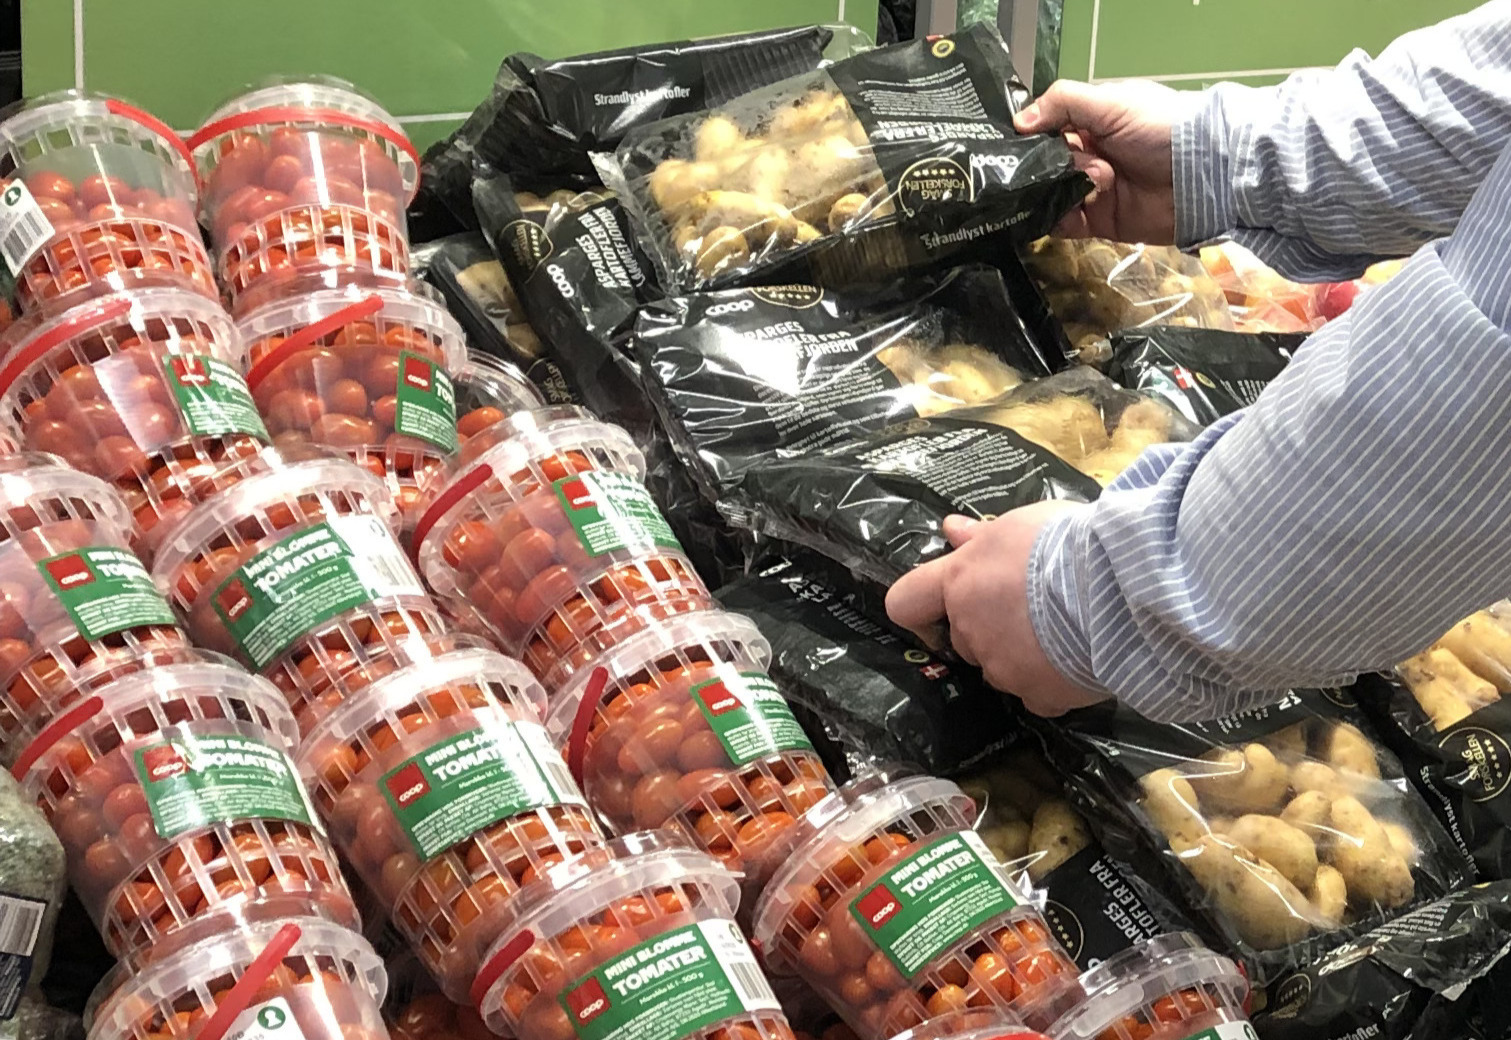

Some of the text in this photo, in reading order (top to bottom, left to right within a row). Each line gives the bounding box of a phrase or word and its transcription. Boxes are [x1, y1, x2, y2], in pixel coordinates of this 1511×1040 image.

[920, 226, 985, 250] Strandlyst
[575, 234, 618, 289] ASPARGES
[547, 264, 575, 298] coop
[705, 299, 755, 316] coop
[742, 321, 804, 341] PARGES
[796, 338, 859, 359] FJORDEN
[254, 541, 344, 591] TOMATER
[229, 596, 248, 617] coop
[424, 744, 458, 766] MINI
[432, 747, 501, 781] TOMAT
[1466, 734, 1496, 792] FORSKELLEN
[153, 761, 183, 776] coop
[399, 782, 424, 802] coop
[890, 862, 920, 886] MINI
[900, 849, 976, 898] TOMATER
[1088, 859, 1160, 935] TOFLER FRA
[872, 901, 896, 923] coop
[1102, 901, 1148, 946] ARGES
[604, 930, 697, 981] MINI BLOMME
[611, 945, 708, 997] TOMATER
[682, 972, 698, 984] 500
[579, 998, 605, 1019] coop
